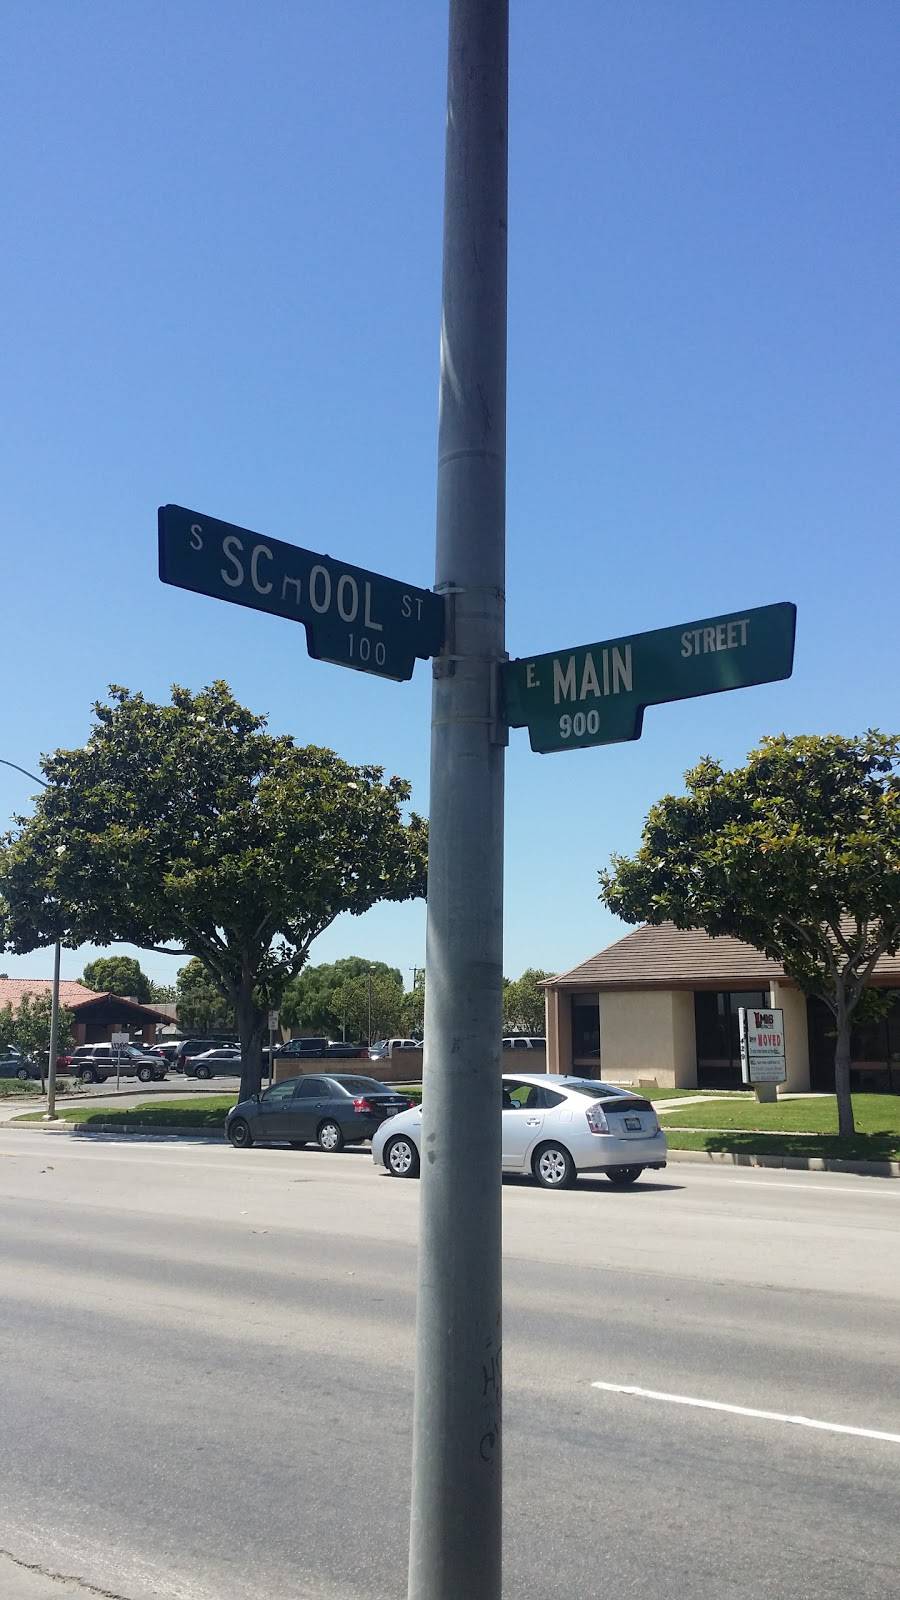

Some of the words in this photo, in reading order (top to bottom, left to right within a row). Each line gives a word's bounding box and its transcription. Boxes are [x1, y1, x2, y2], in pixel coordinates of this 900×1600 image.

[189, 523, 203, 551] S
[400, 594, 424, 621] ST
[347, 632, 387, 666] 100
[526, 663, 541, 688] E.
[552, 643, 633, 705] MAIN
[680, 618, 751, 658] STREET
[558, 709, 600, 739] 900
